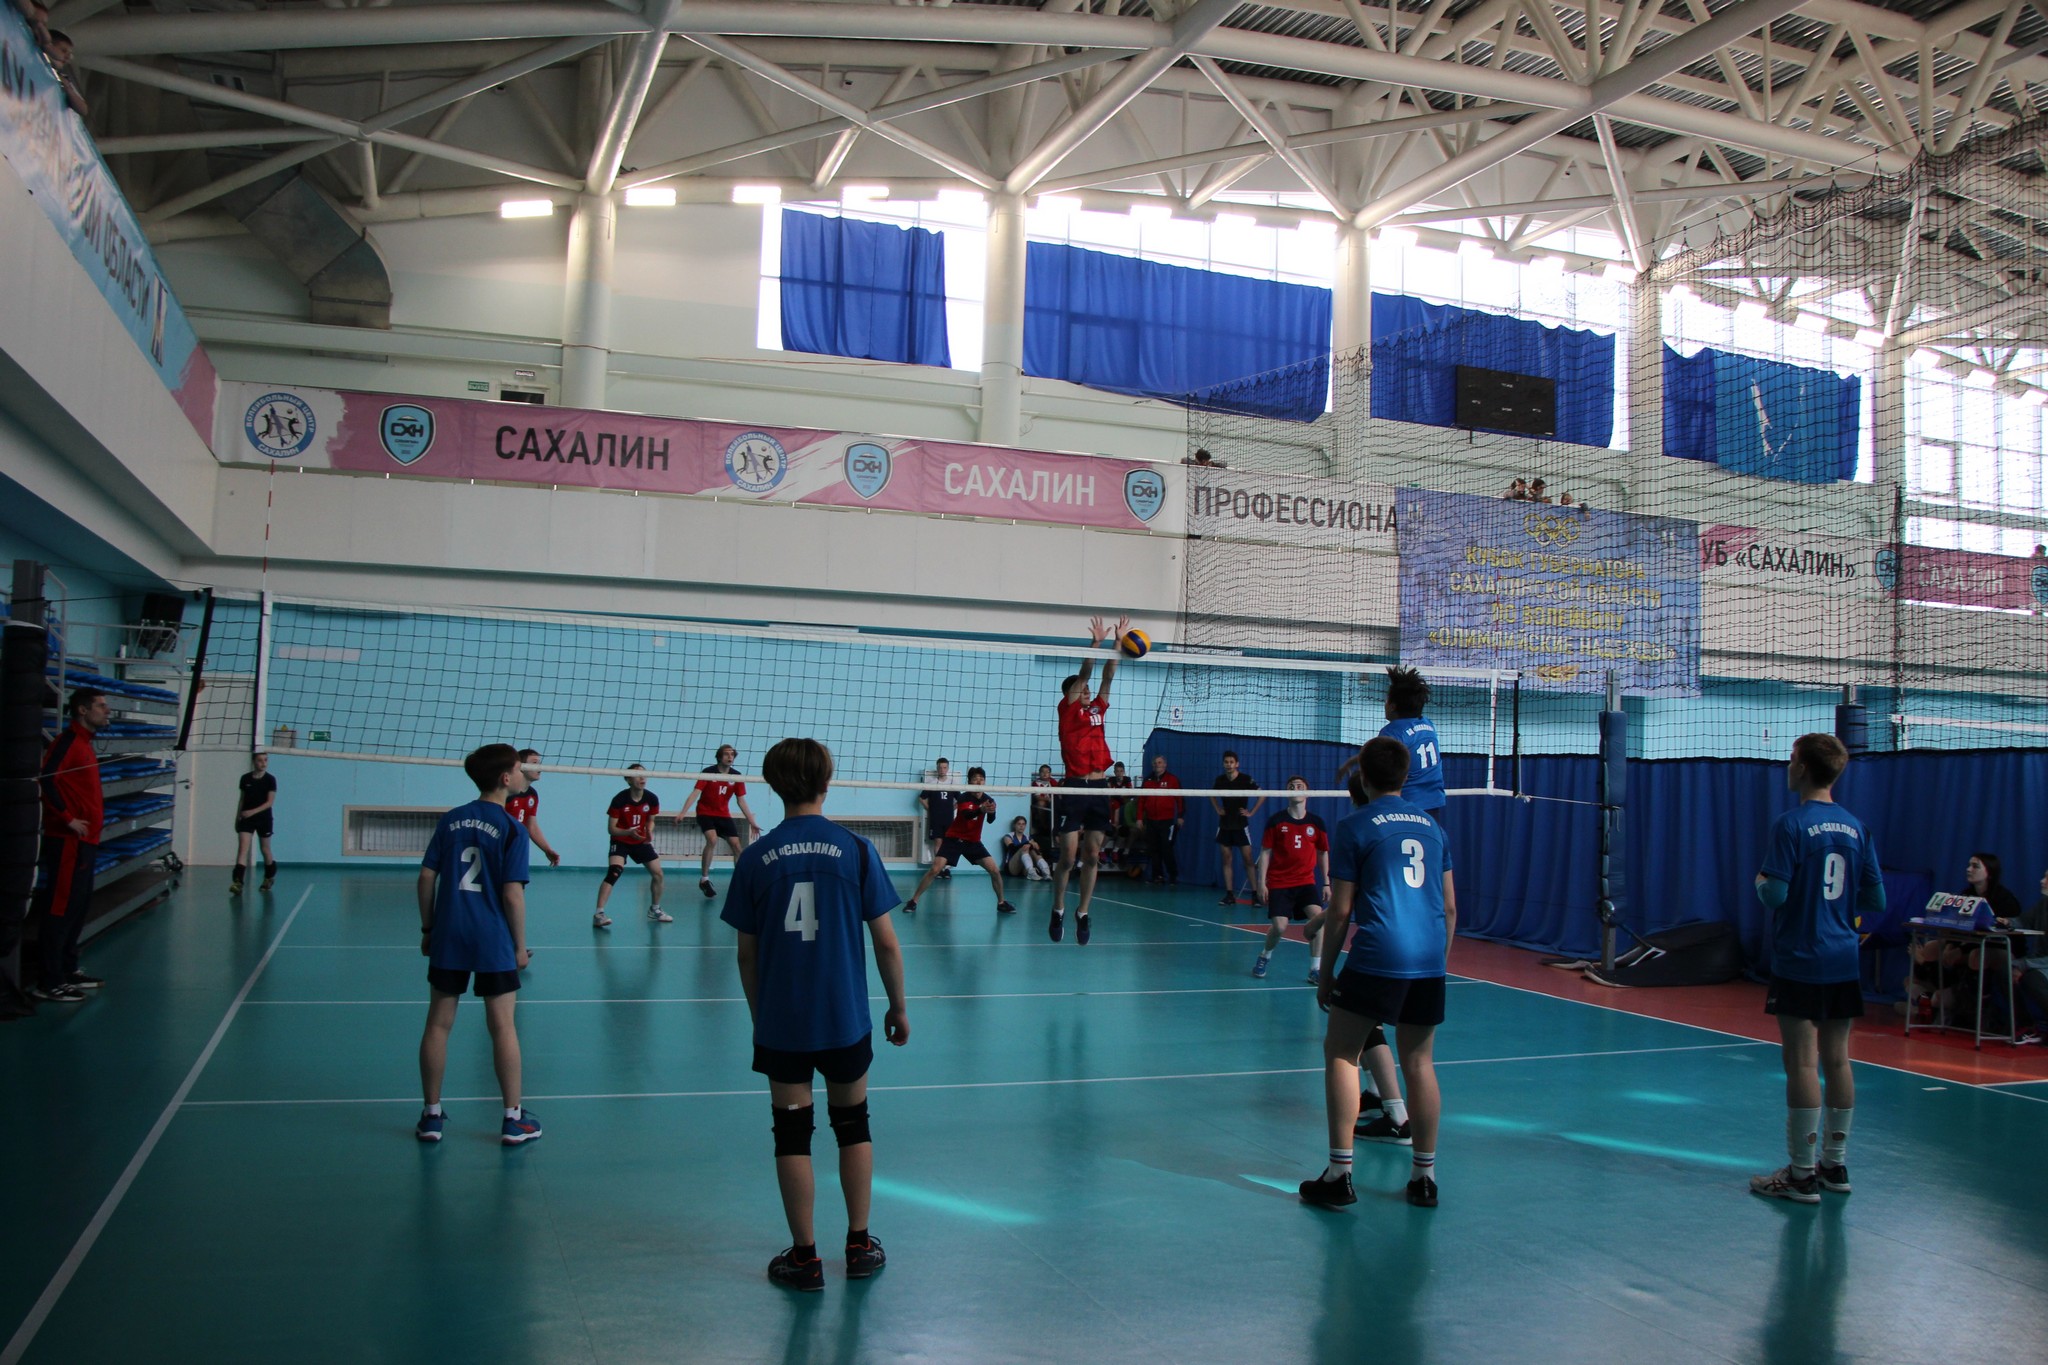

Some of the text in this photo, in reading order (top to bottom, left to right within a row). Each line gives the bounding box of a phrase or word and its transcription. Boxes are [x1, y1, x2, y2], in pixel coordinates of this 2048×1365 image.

[103, 212, 150, 326] ОБЛАСТИ
[257, 444, 299, 456] САХАЛИН
[495, 425, 670, 471] САХАЛИН
[737, 479, 773, 491] САХАЛИН
[944, 462, 1095, 506] САХАЛИН
[1465, 546, 1645, 580] КУБОК ГУБЕРНАТОРА
[1735, 543, 1856, 578] «САХАЛИН»
[1450, 572, 1662, 607] САХАЛИНСКОЙ ОБЛАСТИ
[1919, 562, 2004, 595] САХАЛИН
[1492, 603, 1624, 632] ПО ВОЛЕЙБОЛУ
[1416, 741, 1438, 769] 11
[762, 841, 842, 867] ВЦ «САХАЛИН»
[1294, 834, 1302, 849] 5
[459, 846, 482, 892] 2
[1401, 838, 1425, 888] 3
[1823, 852, 1846, 900] 9
[784, 881, 819, 942] 4
[1963, 900, 1975, 912] 3
